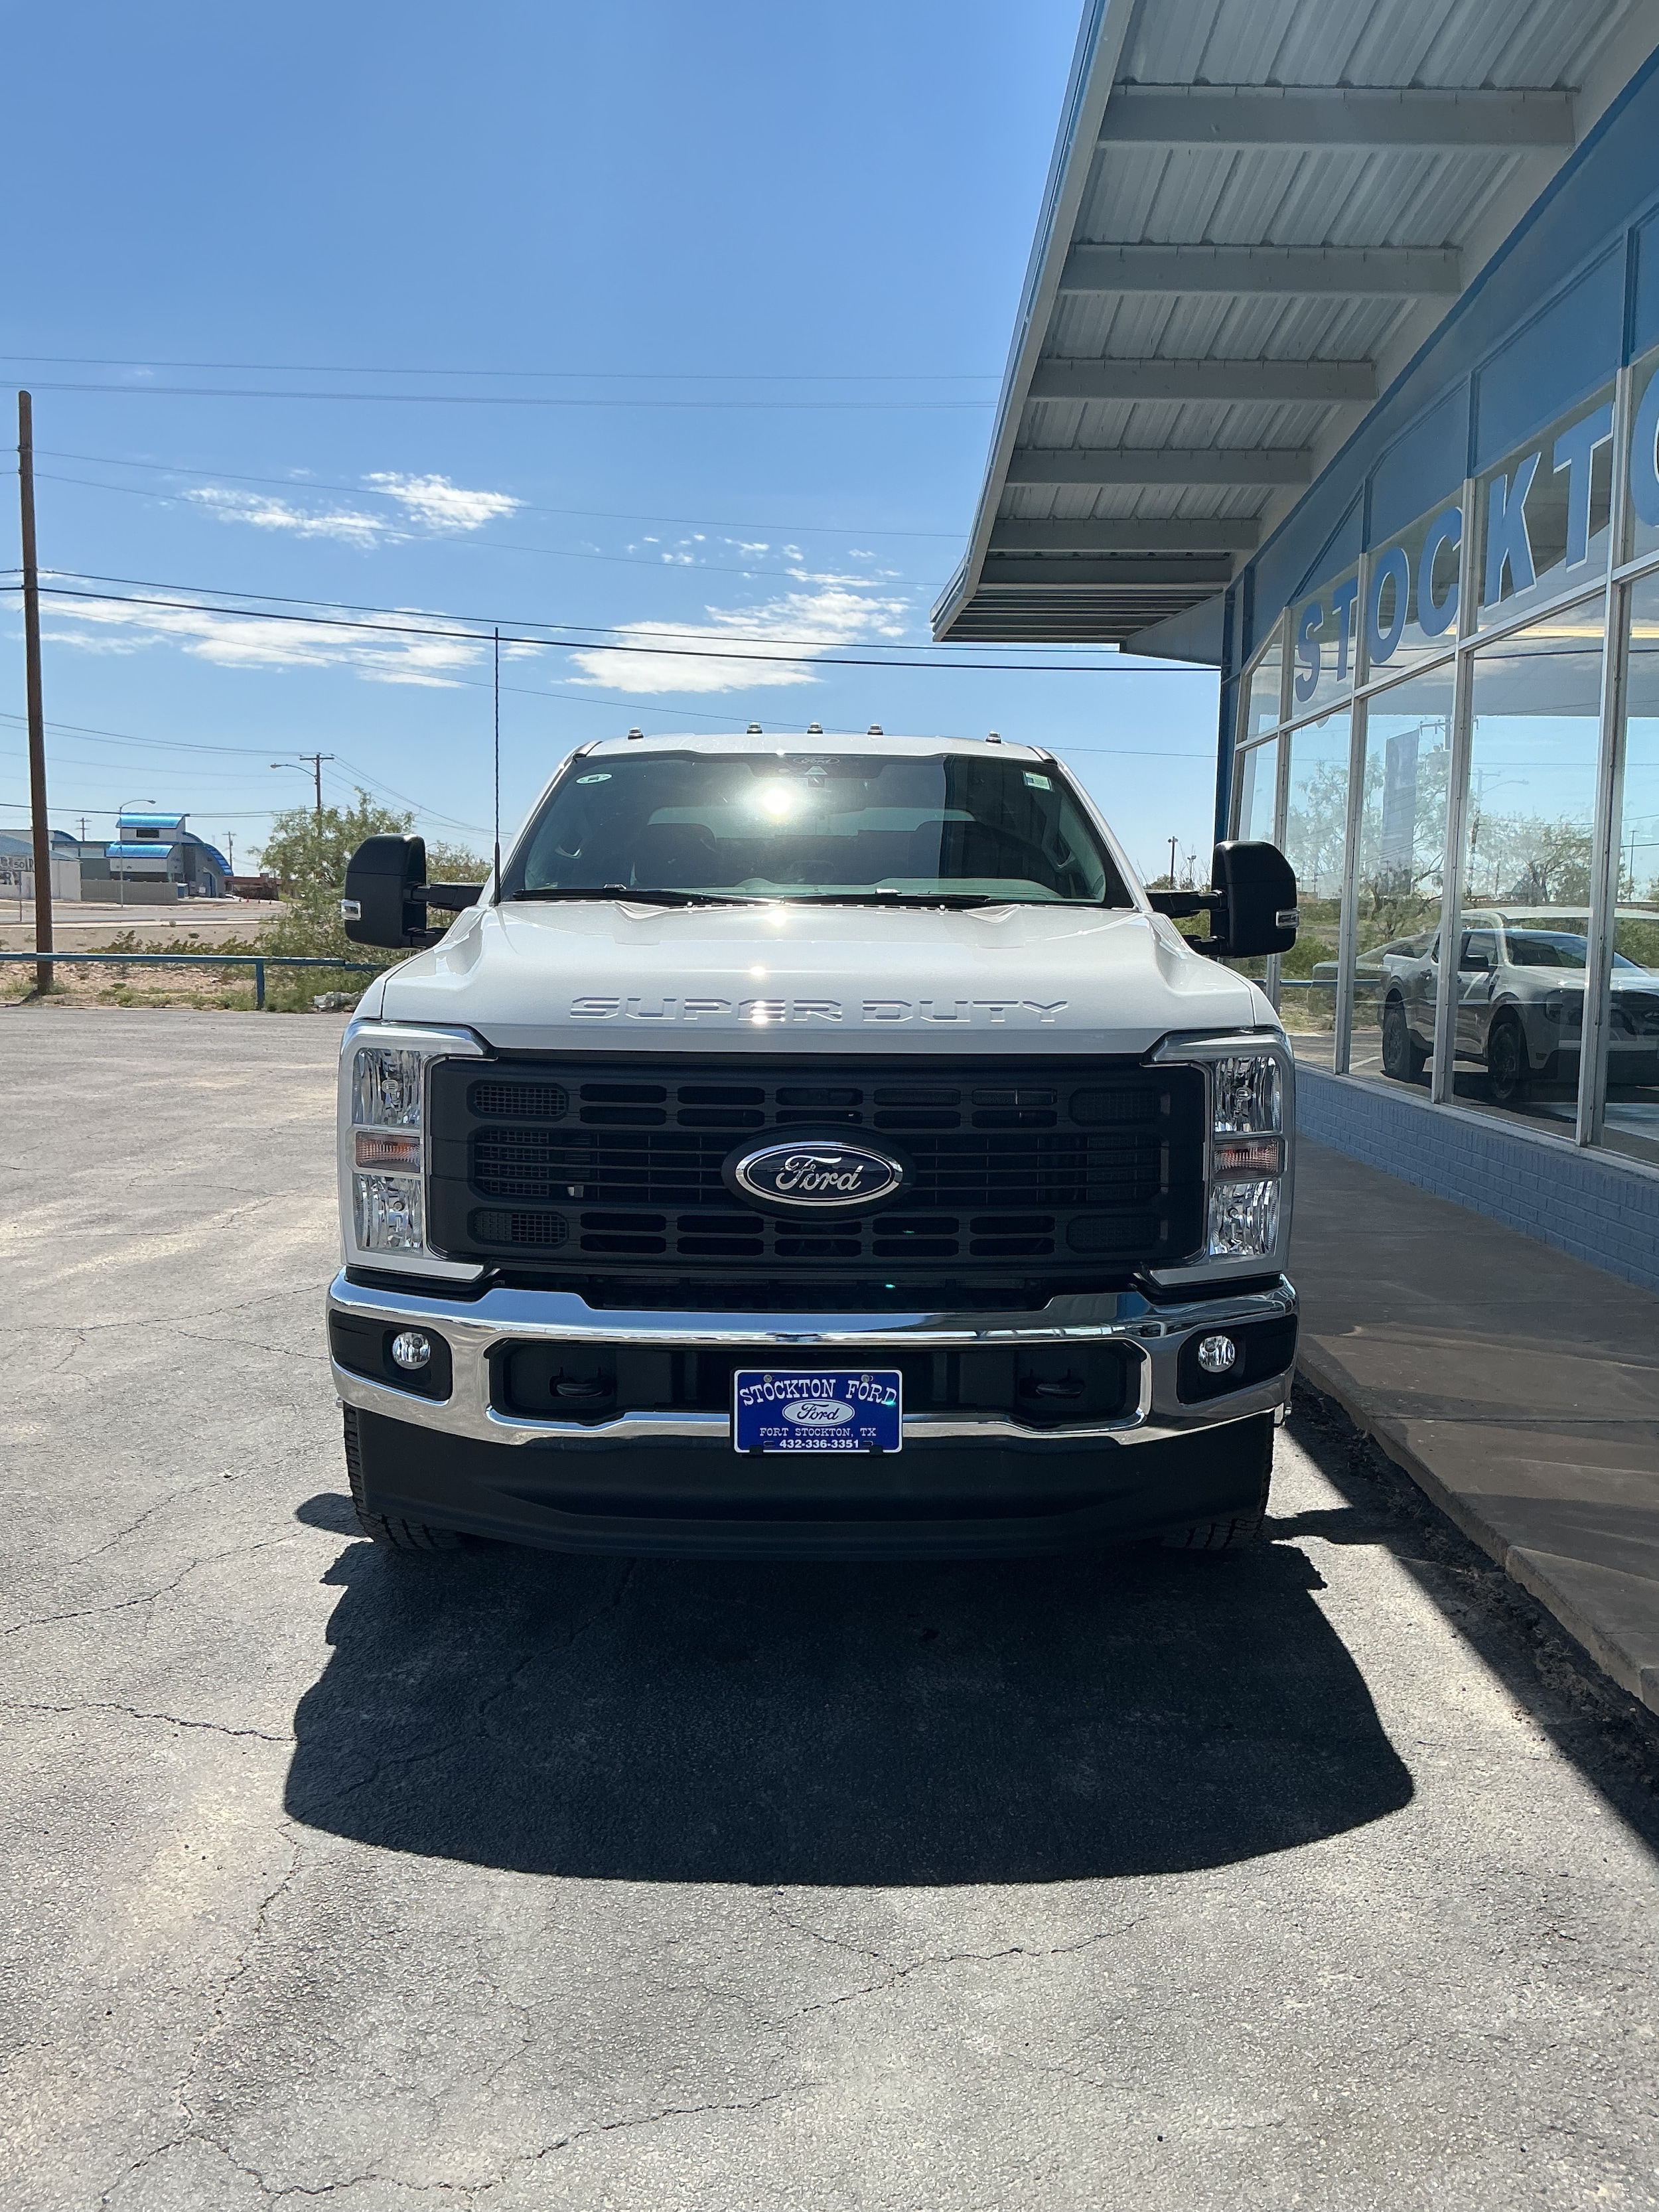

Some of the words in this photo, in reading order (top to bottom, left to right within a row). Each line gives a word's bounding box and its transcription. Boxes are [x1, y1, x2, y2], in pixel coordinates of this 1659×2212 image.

[569, 997, 842, 1022] SUPER
[863, 1000, 1068, 1022] DUTY
[775, 1155, 864, 1191] Ford
[739, 1379, 836, 1406] STOCKTON
[845, 1380, 897, 1406] FORD
[797, 1403, 840, 1420] Ford
[760, 1428, 789, 1436] FORT
[795, 1428, 853, 1438] STOCKTON,
[860, 1428, 877, 1436] TX
[779, 1439, 859, 1448] 432-336-3351
